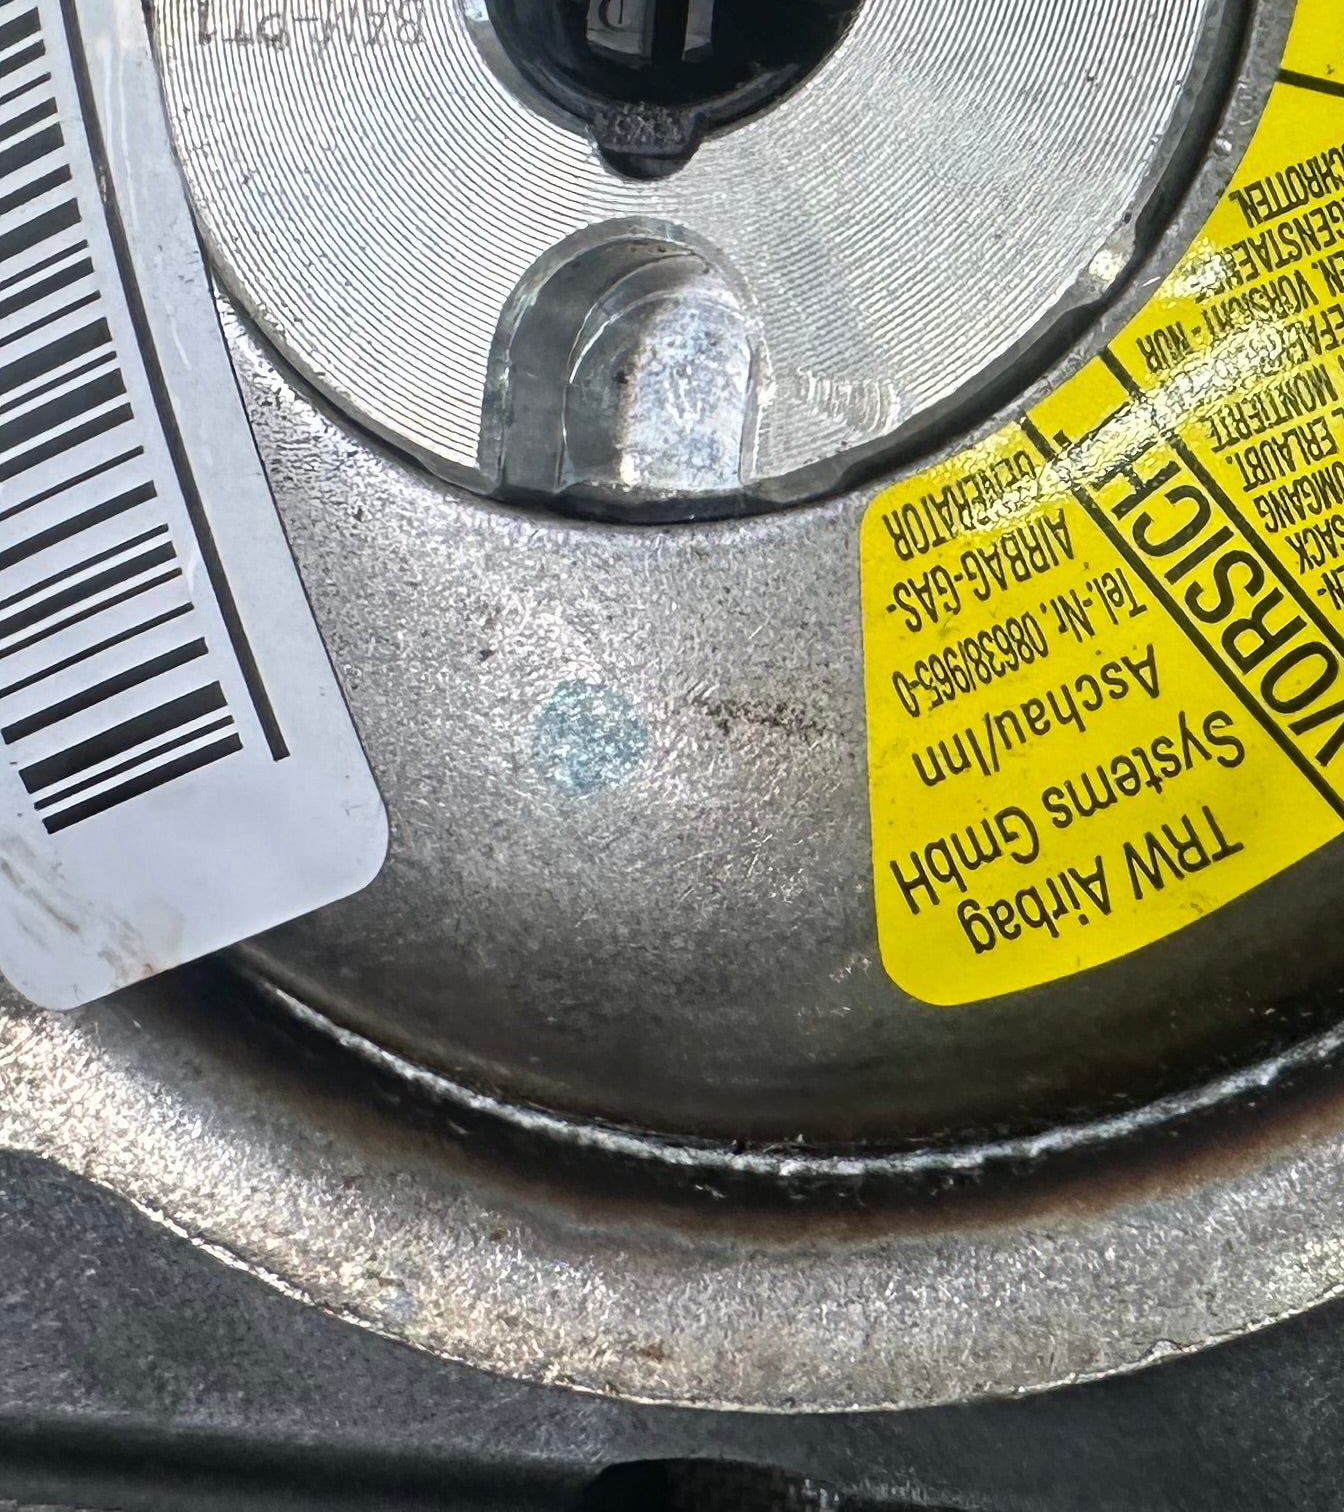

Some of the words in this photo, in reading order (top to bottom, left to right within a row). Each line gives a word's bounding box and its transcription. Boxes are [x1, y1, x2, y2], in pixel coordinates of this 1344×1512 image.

[1135, 321, 1194, 374] NUR
[881, 450, 1045, 562] GENERATOR
[1225, 415, 1338, 493] ERLAUBT.
[886, 508, 1074, 633] AIRBAG-GAS-
[1039, 559, 1148, 643] Tel.-Nr.
[892, 611, 1049, 718] 08638/965-0
[911, 643, 1160, 787] Aschau/Inn
[1041, 710, 1246, 829] Systems
[889, 805, 1040, 916] GmbH
[957, 854, 1112, 955] Airbag
[1122, 805, 1245, 901] TRW
